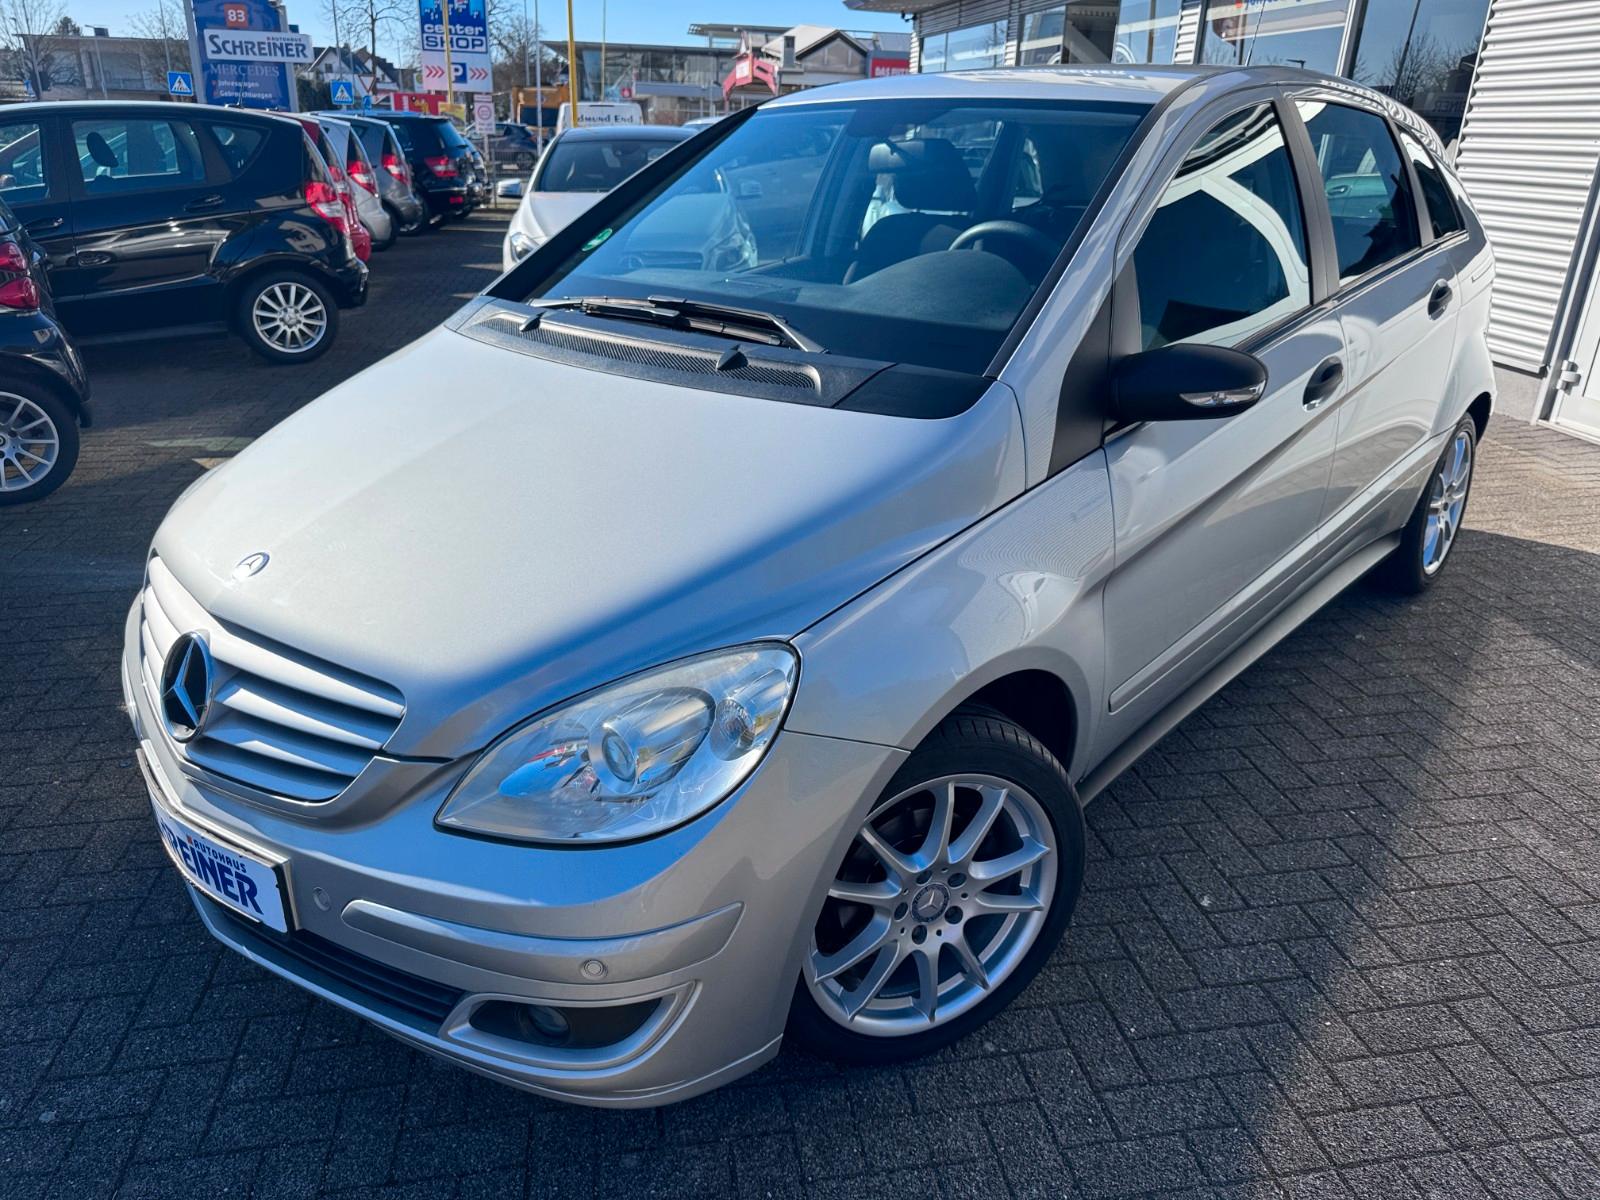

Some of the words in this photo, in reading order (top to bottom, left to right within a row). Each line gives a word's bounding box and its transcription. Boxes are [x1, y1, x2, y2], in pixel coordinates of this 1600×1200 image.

[227, 9, 246, 22] 83
[423, 23, 484, 36] center
[208, 34, 308, 58] SCHREINER
[425, 35, 484, 50] SHOP
[209, 63, 280, 77] MERCEDES
[193, 840, 247, 874] AUTOHAUS
